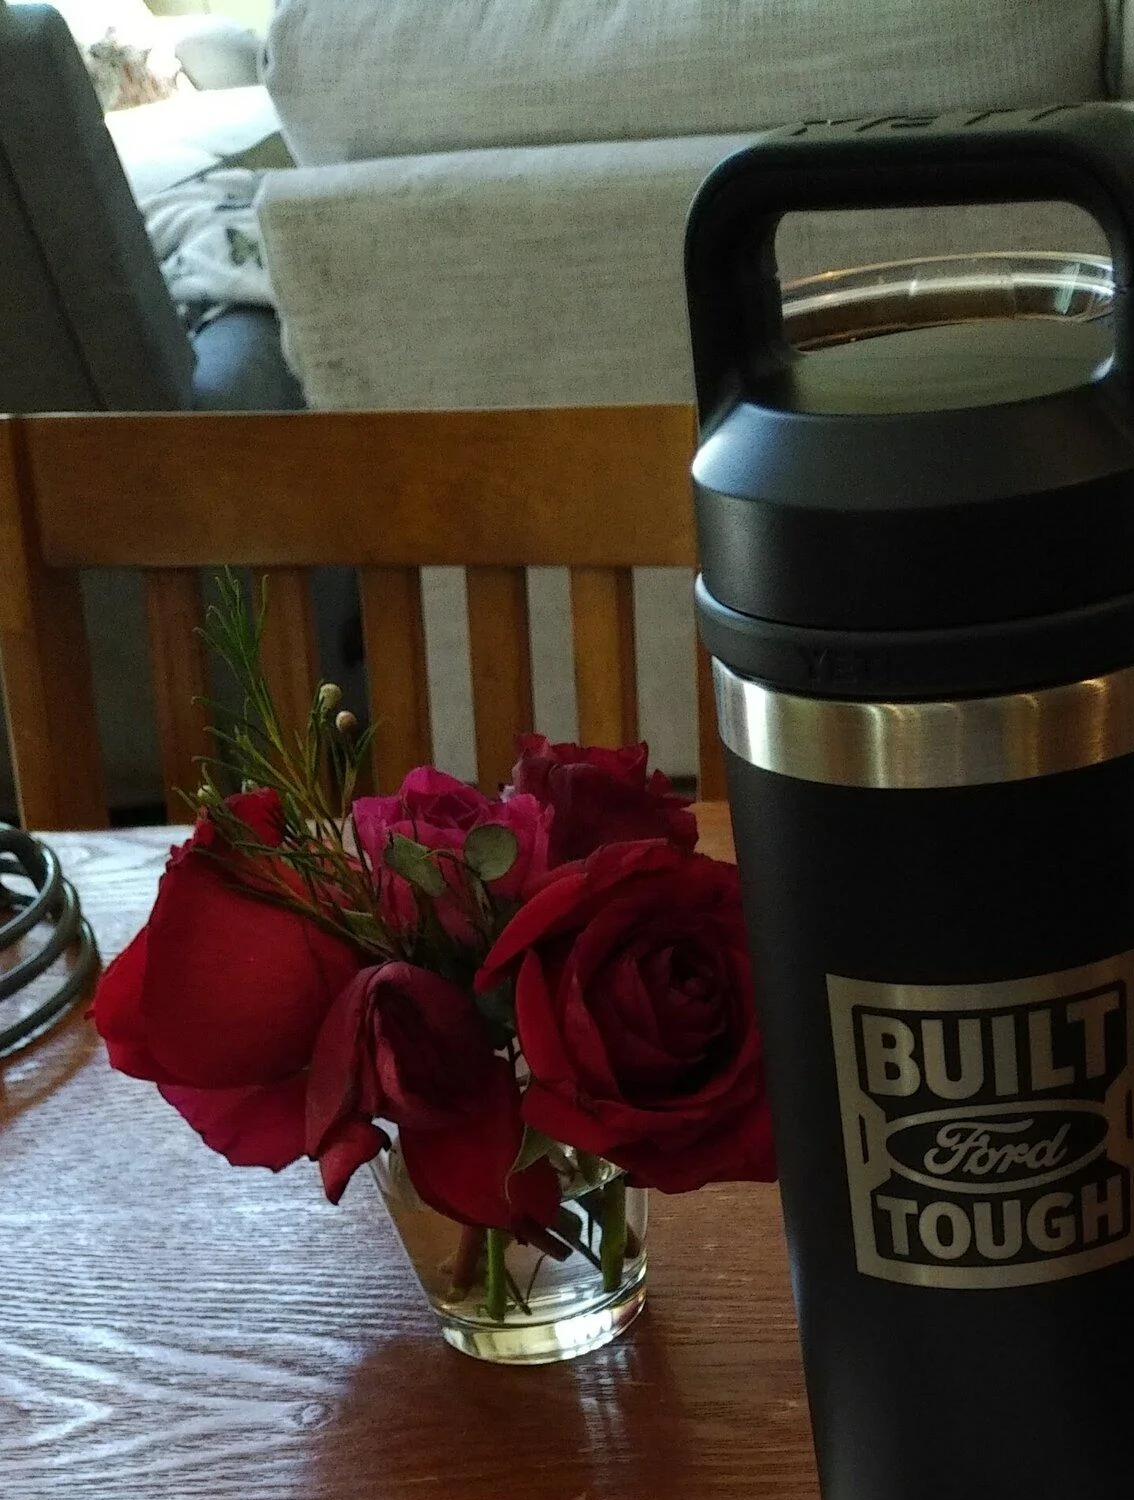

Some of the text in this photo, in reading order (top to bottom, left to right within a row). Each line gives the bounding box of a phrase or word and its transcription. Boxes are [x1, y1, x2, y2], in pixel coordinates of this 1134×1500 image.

[861, 993, 1121, 1098] BUILT
[924, 1120, 1069, 1175] Ford
[878, 1191, 1123, 1260] TOUGH
